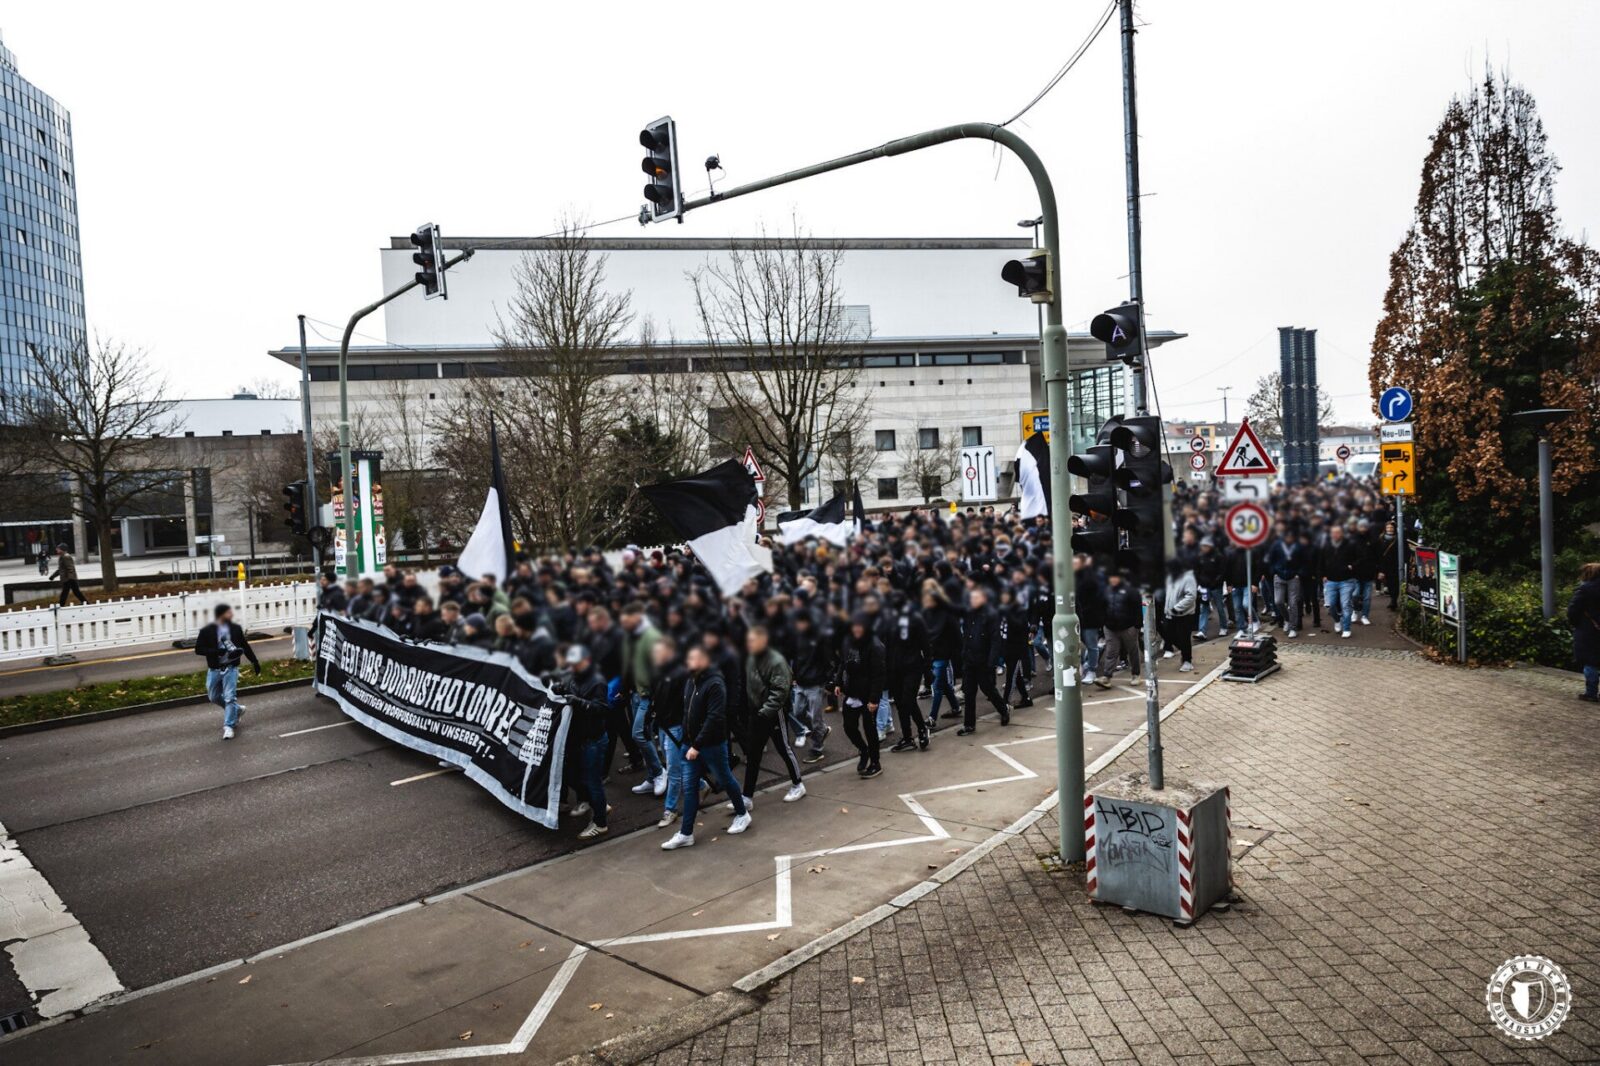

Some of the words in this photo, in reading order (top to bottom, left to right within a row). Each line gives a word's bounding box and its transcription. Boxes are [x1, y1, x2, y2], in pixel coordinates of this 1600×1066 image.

[1382, 429, 1411, 439] Neu-Ulm
[1235, 514, 1260, 534] 30
[359, 648, 383, 686] DAS
